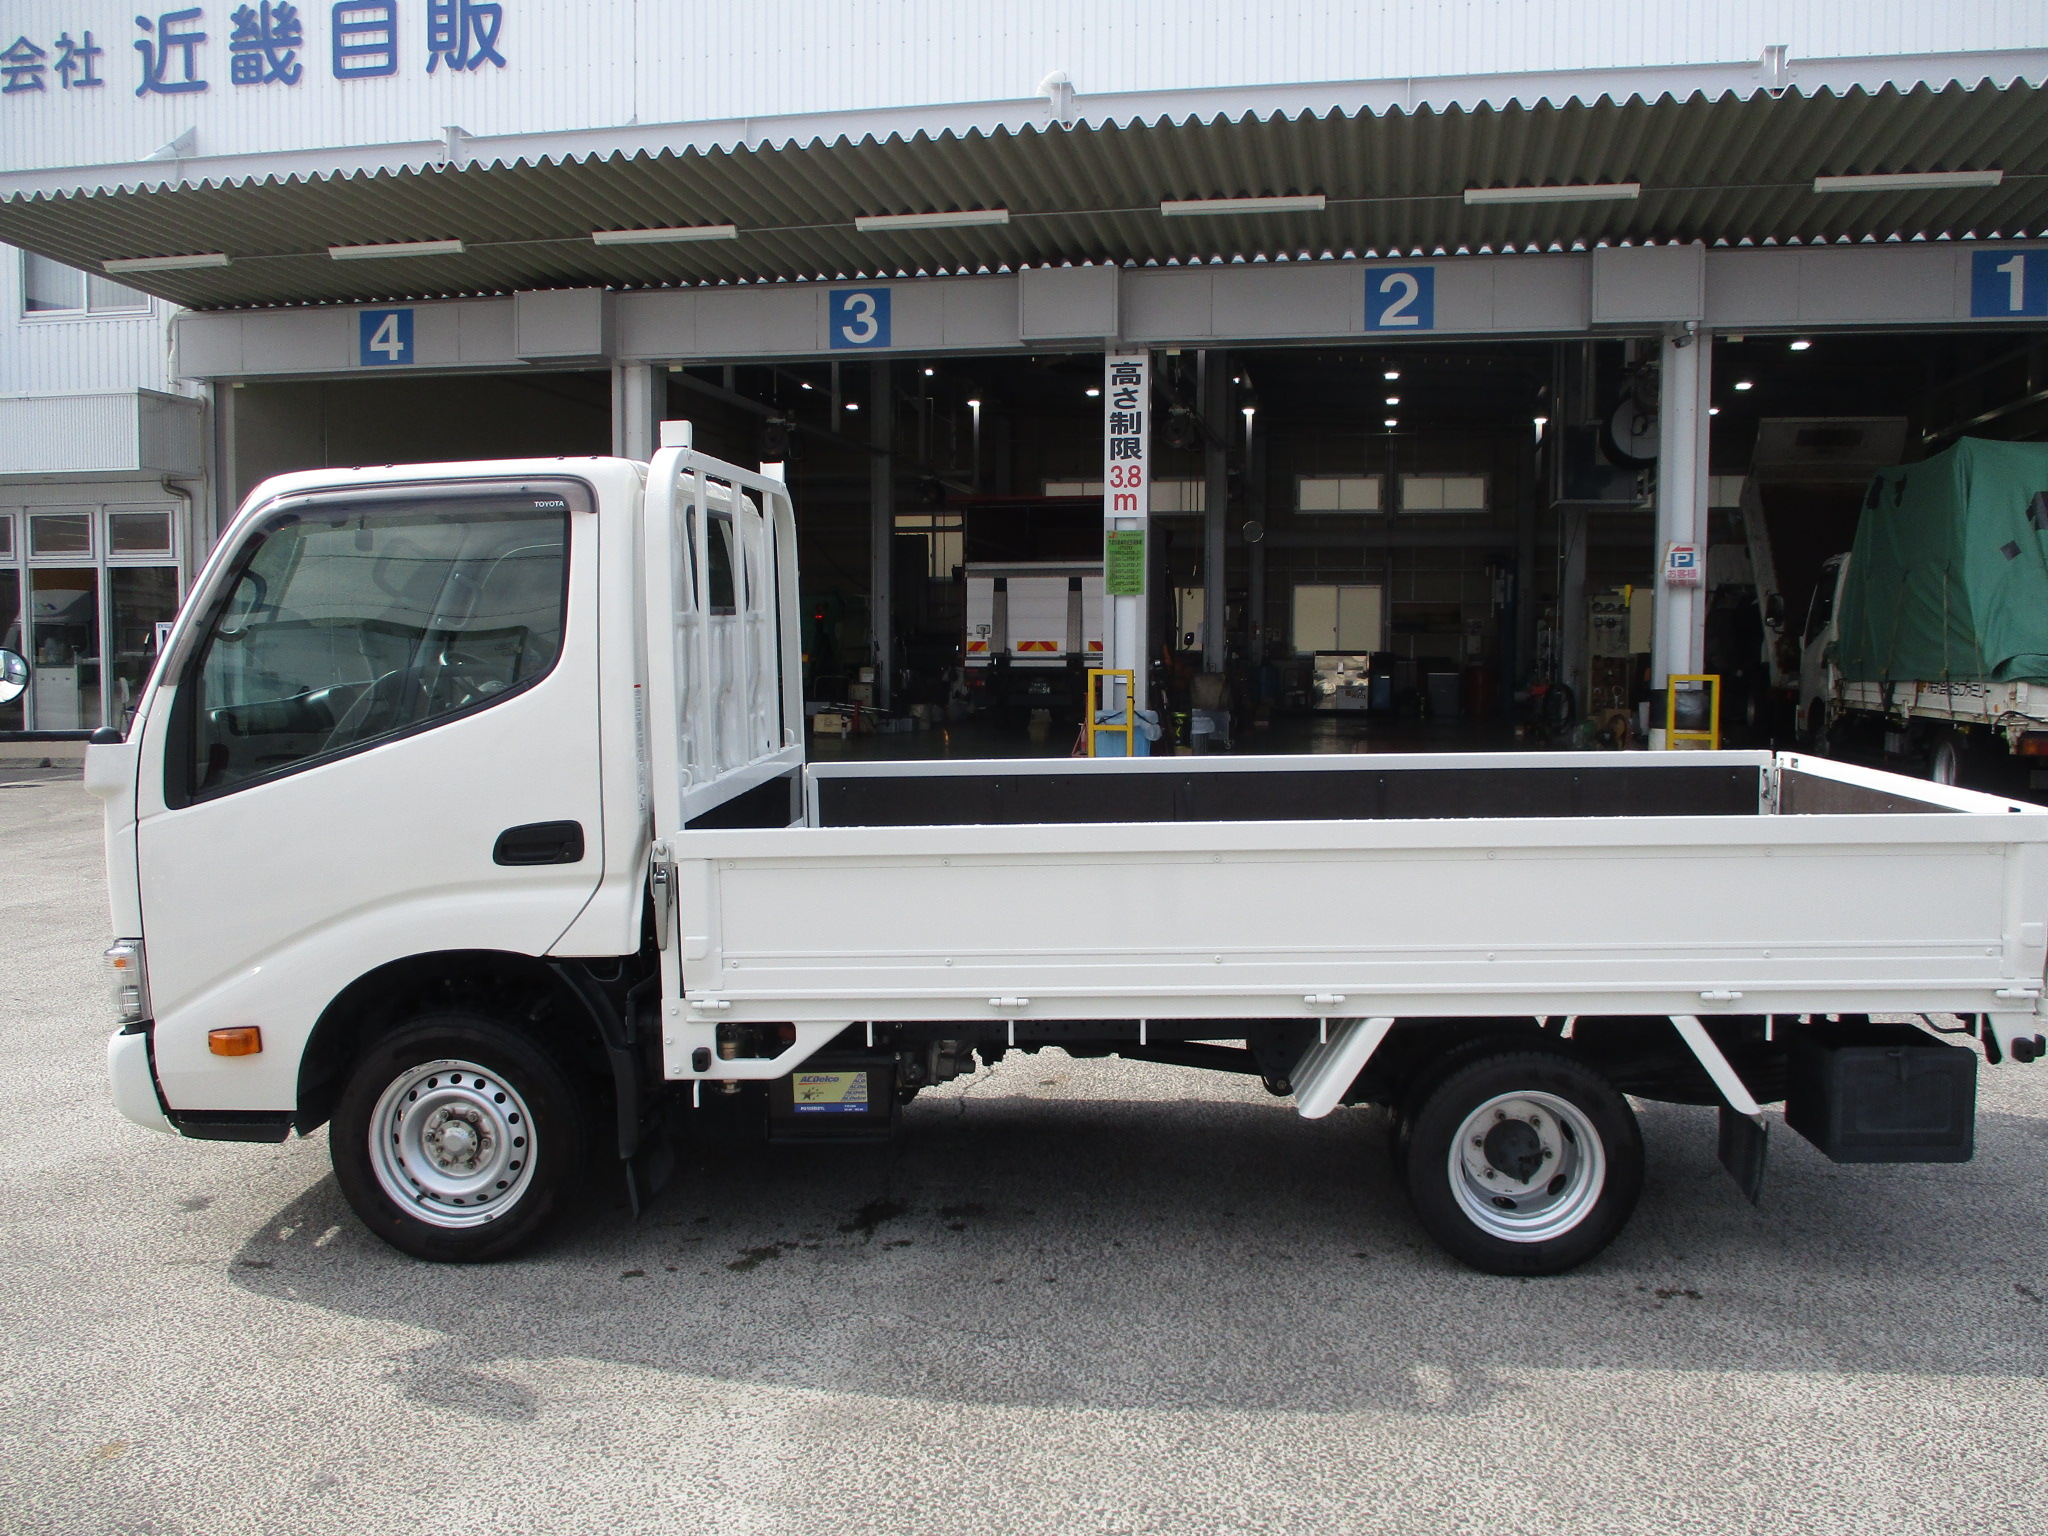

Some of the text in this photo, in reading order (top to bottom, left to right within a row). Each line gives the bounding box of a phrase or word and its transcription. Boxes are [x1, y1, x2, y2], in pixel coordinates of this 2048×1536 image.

[1379, 272, 1419, 327] 2
[1997, 255, 2024, 311] 1
[842, 293, 878, 344] 3
[370, 314, 404, 361] 4
[1110, 362, 1143, 461] 高さ制限
[1110, 465, 1142, 488] 3.8
[534, 500, 565, 508] TOYOTA
[1114, 493, 1138, 511] m
[1674, 553, 1691, 567] P
[800, 1075, 840, 1083] ACDelco
